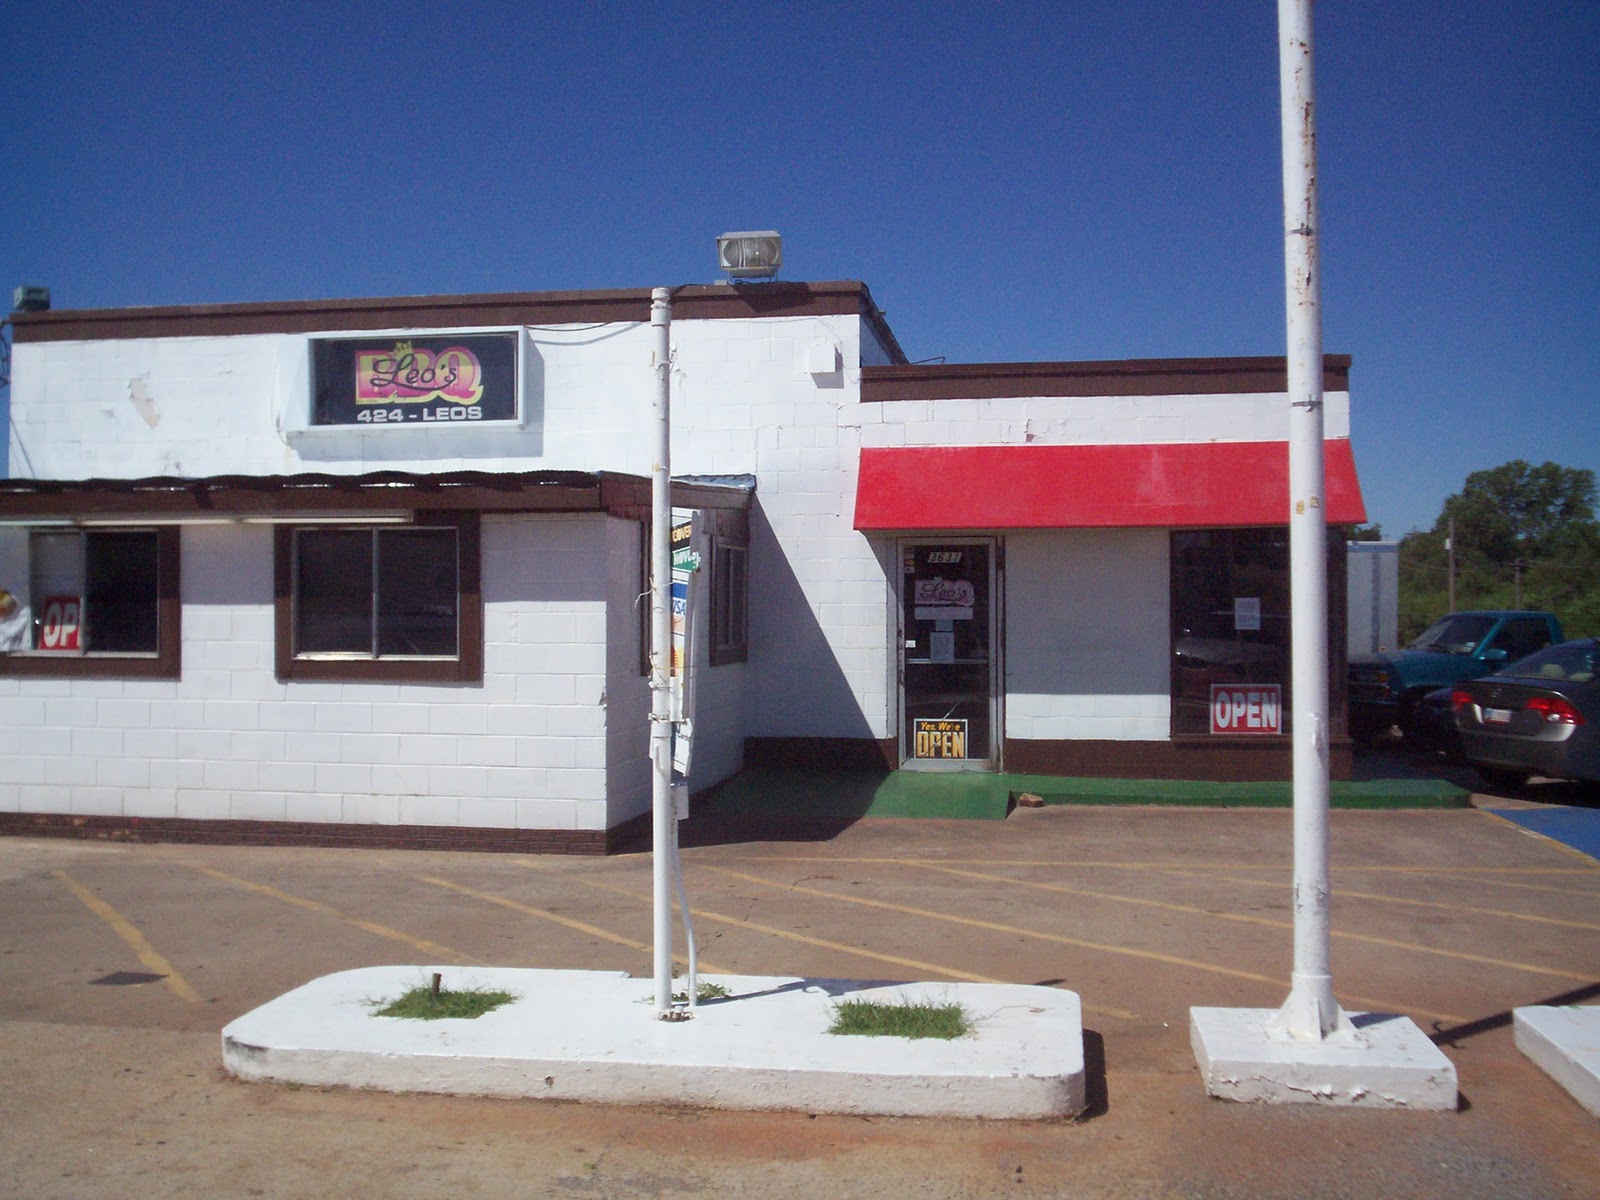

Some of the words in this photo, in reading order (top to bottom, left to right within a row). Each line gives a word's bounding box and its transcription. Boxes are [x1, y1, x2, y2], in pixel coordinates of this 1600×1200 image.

[370, 353, 457, 391] Leo's
[43, 602, 80, 648] OP
[1215, 691, 1277, 728] OPEN
[917, 731, 964, 758] OPEN
